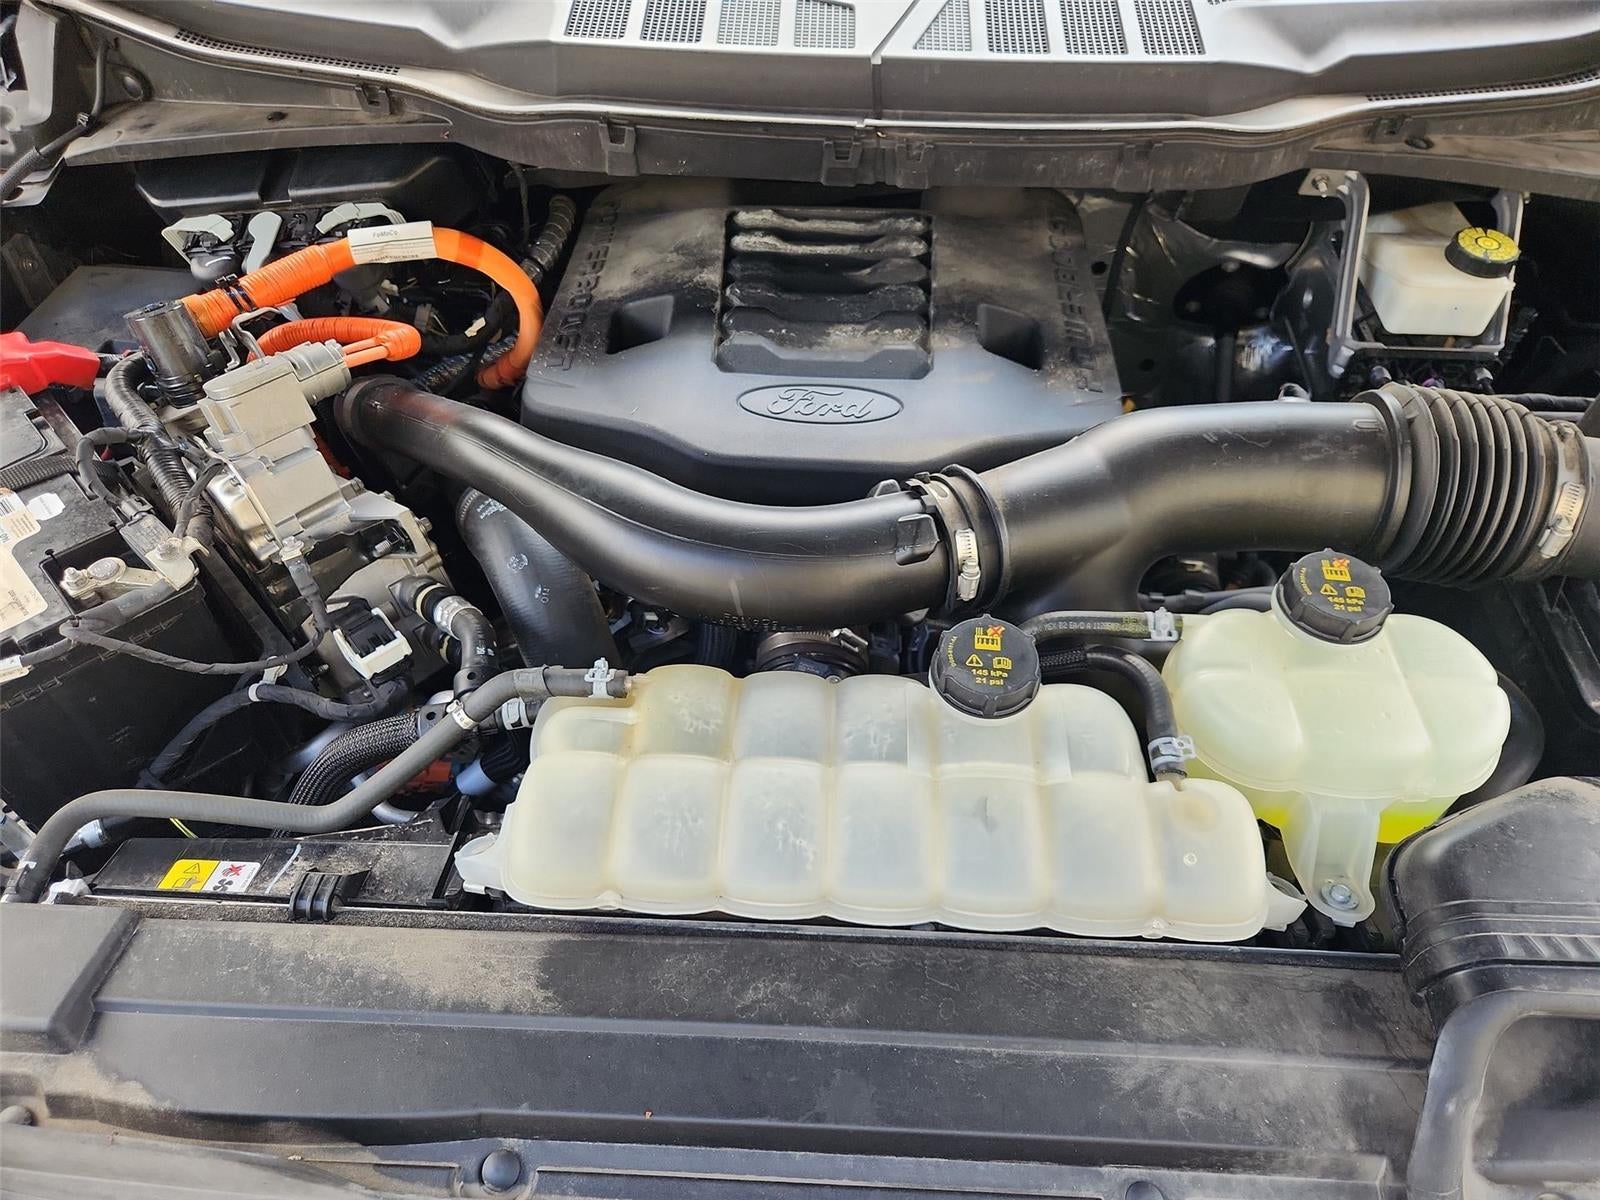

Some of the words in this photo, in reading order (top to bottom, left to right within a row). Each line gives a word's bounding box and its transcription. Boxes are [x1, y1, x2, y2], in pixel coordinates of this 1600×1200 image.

[767, 388, 875, 418] Ford
[990, 670, 1008, 678] kPa
[989, 678, 1004, 686] psi
